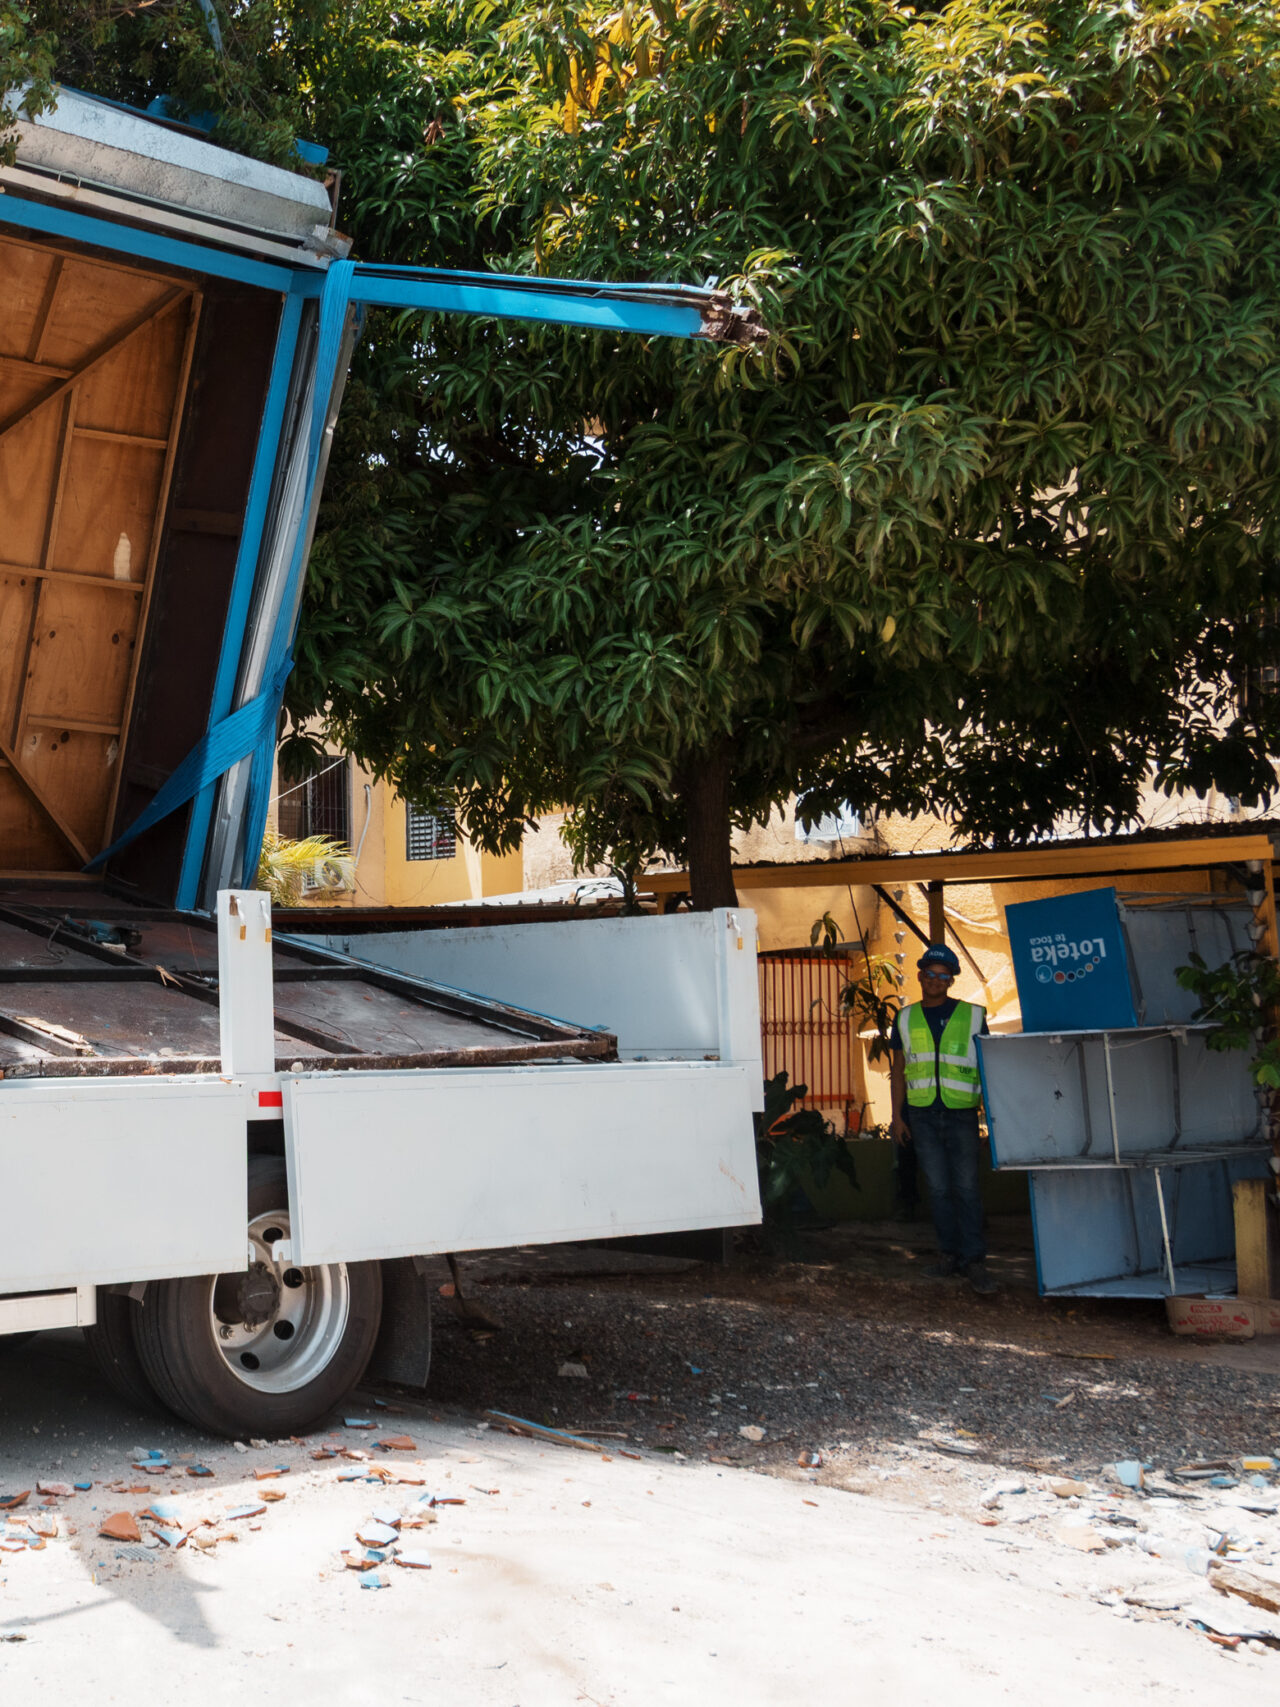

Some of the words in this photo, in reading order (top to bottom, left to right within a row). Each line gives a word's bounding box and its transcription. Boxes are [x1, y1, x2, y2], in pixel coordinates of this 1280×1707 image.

[1029, 935, 1053, 945] toca
[1054, 933, 1066, 942] te
[1031, 938, 1107, 966] Loteka
